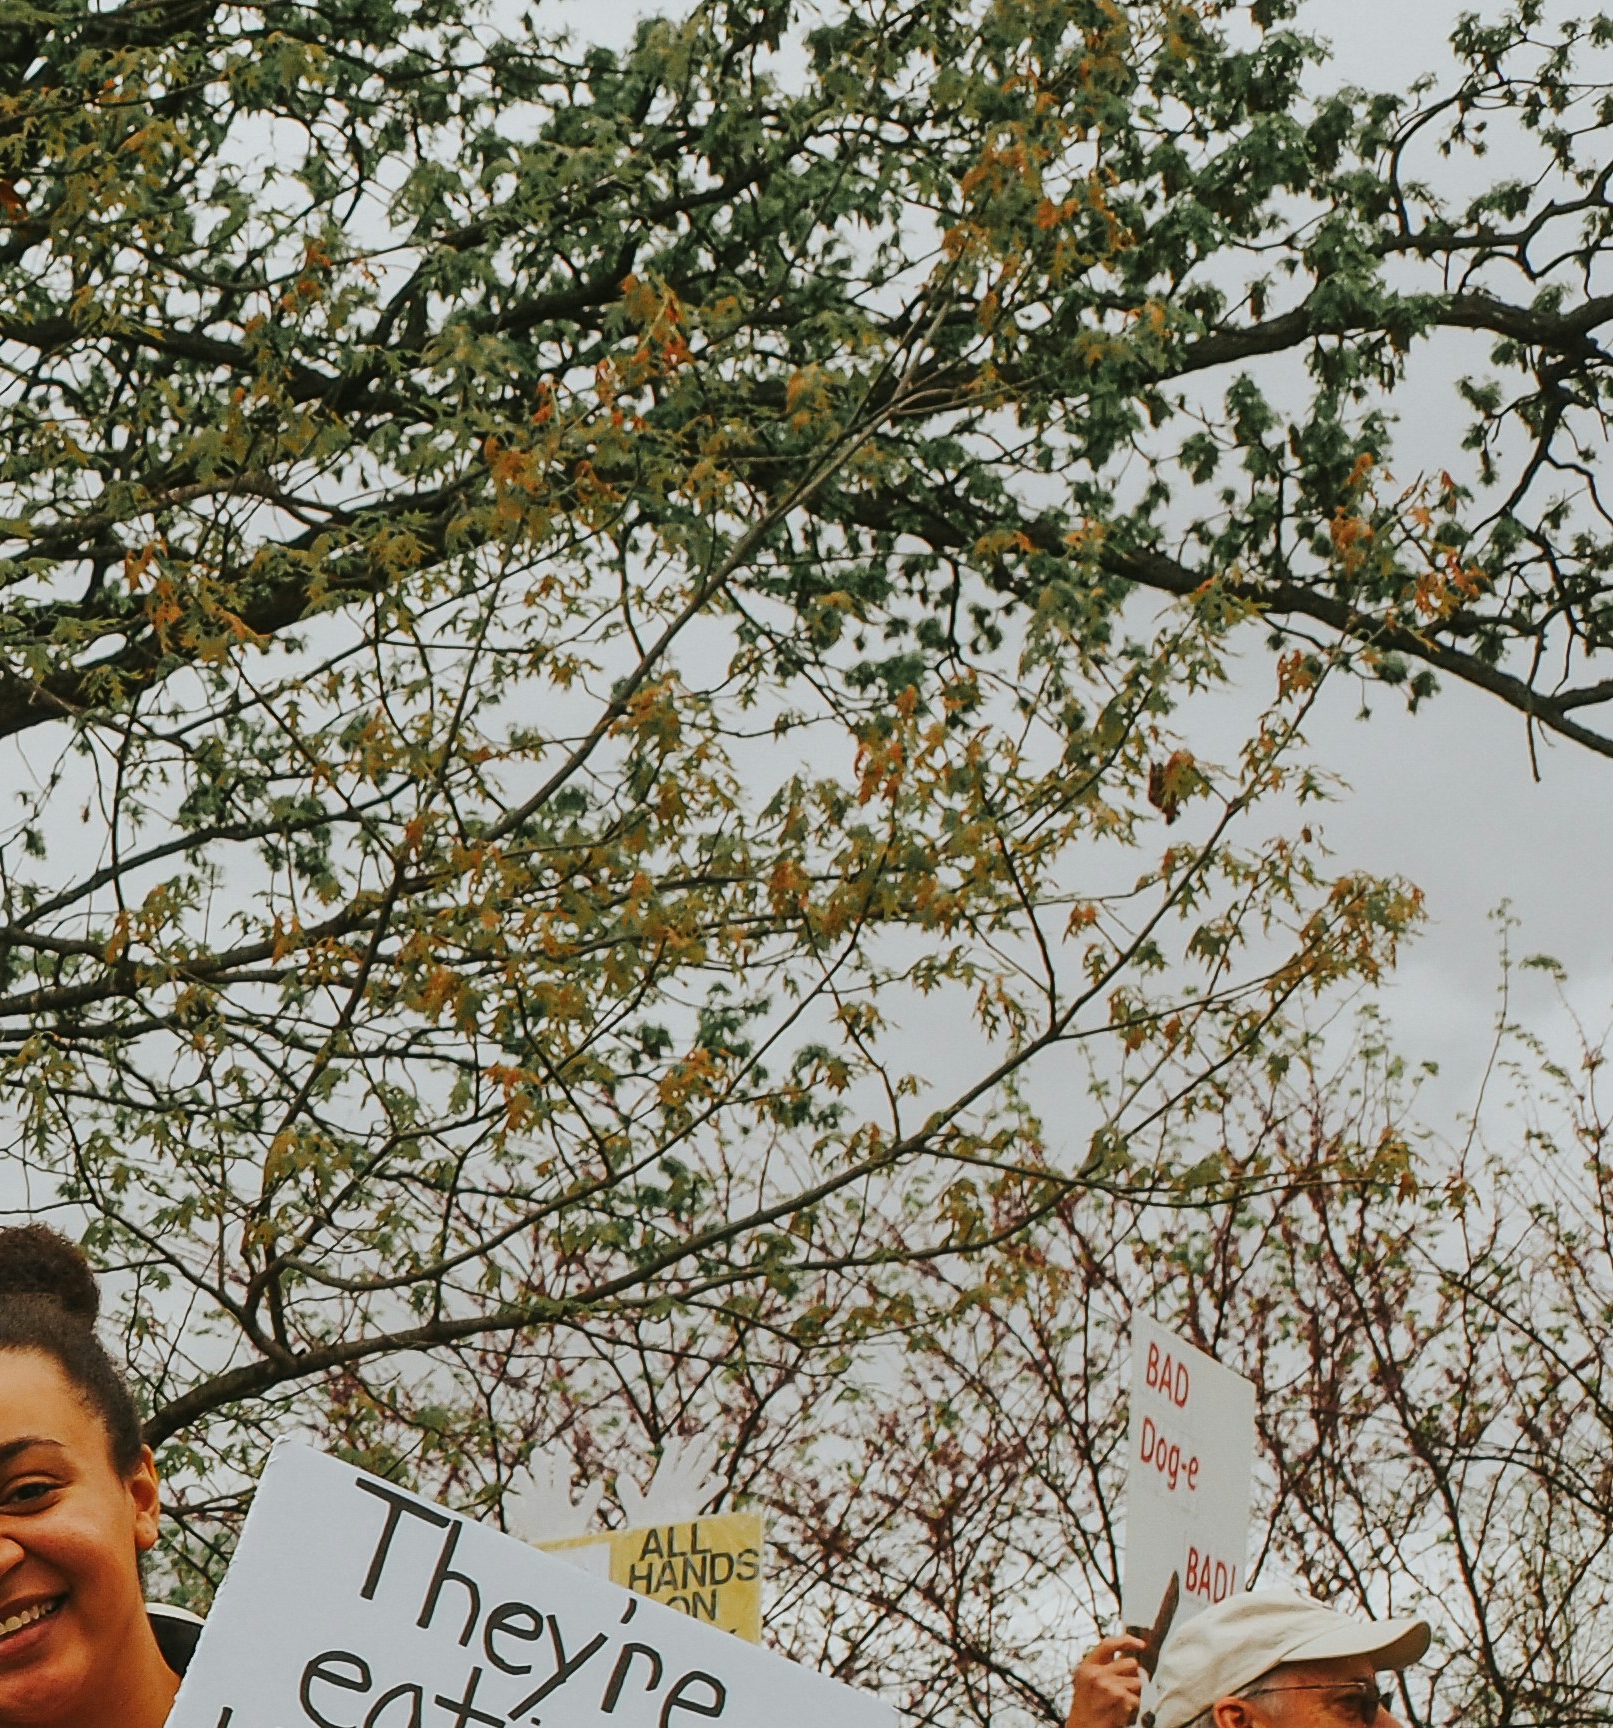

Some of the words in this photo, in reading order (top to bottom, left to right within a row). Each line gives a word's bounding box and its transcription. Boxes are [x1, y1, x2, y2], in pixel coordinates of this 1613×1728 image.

[1146, 1340, 1190, 1409] BAD
[1139, 1417, 1200, 1492] Dog-e
[638, 1522, 713, 1562] ALL
[628, 1547, 760, 1595] HANDS
[664, 1588, 718, 1622] ON
